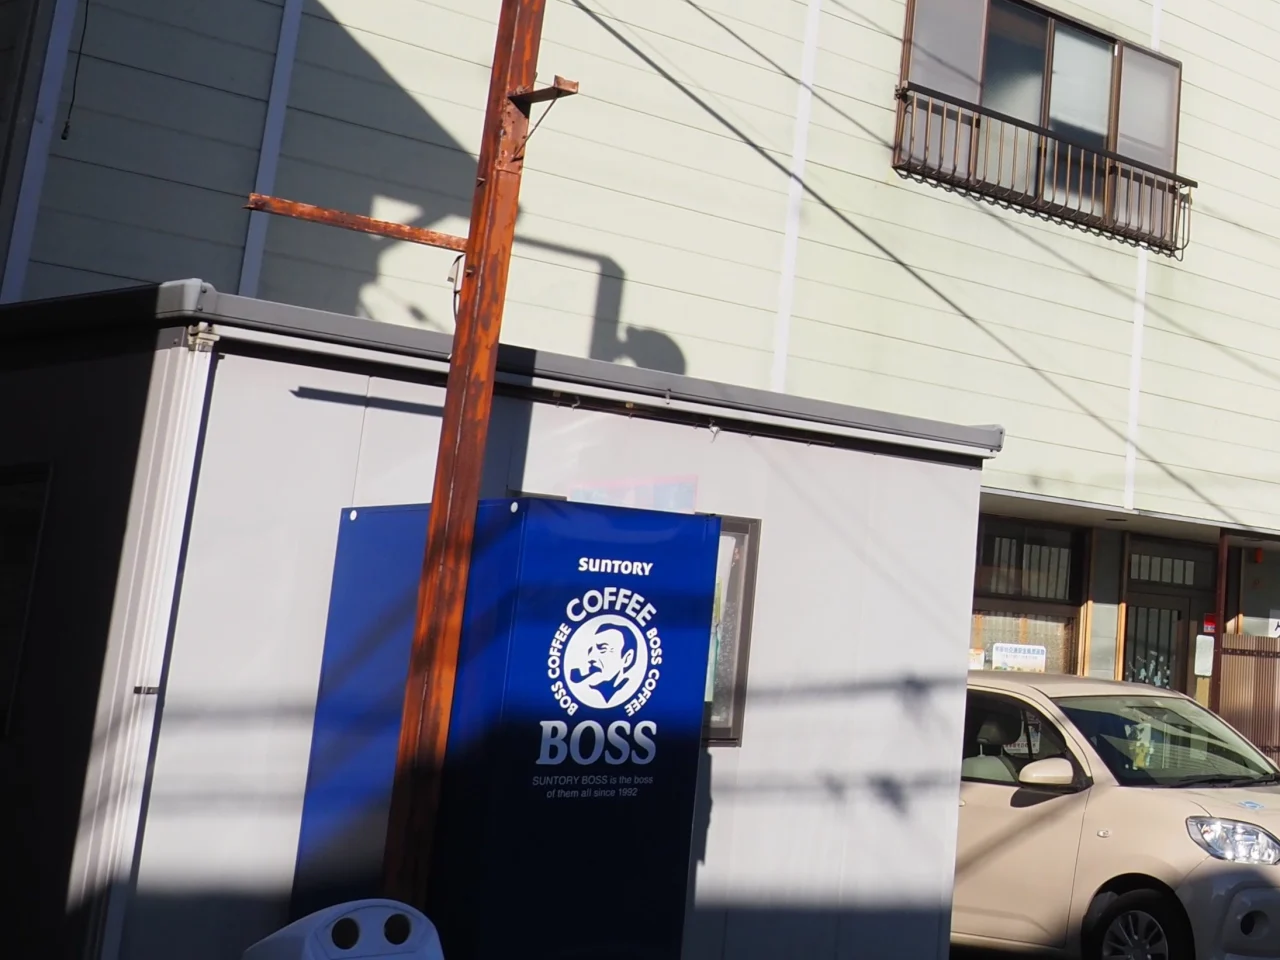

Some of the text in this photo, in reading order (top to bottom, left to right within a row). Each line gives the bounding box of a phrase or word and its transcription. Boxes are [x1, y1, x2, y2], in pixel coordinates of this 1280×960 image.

[578, 557, 653, 576] SUNTORY
[566, 587, 657, 627] COFFEE
[547, 623, 579, 716] BOSS COFFEE
[624, 627, 662, 717] BOSS COFFEE
[536, 720, 657, 765] BOSS
[532, 775, 653, 786] SUNTORY BOSS is the boss
[546, 787, 638, 799] of them all since 1992
